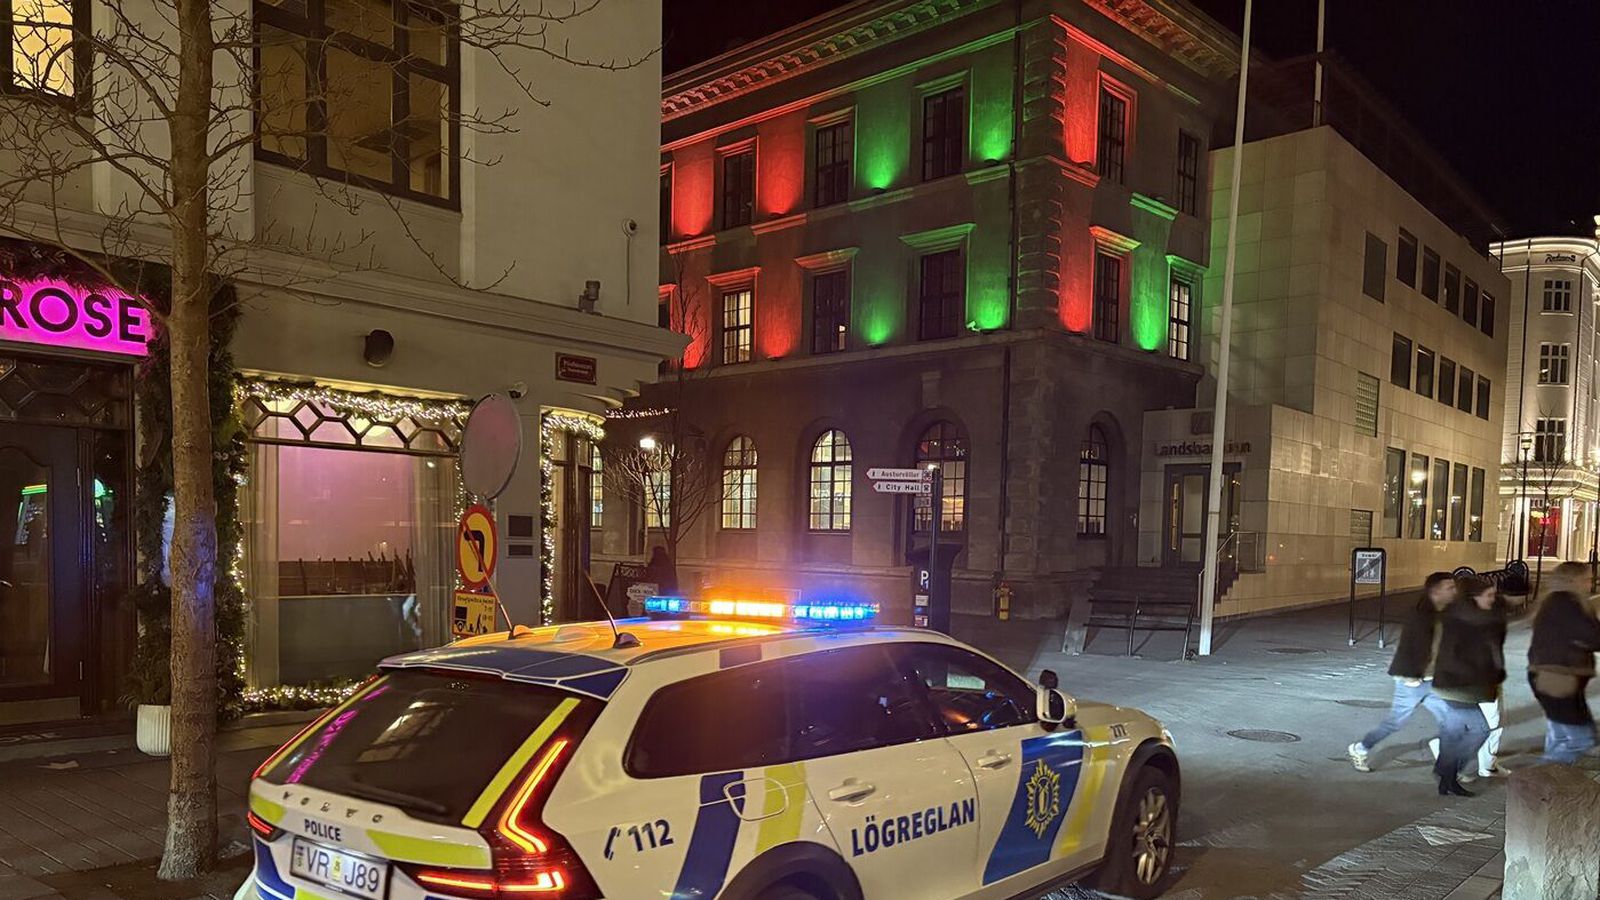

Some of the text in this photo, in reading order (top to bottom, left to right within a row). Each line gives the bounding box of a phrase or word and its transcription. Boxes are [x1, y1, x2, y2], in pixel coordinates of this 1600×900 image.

[0, 280, 146, 343] ROSE
[283, 791, 383, 823] VOLVO
[304, 819, 341, 841] POLICE
[628, 819, 674, 852] 112
[852, 798, 976, 858] LÖGREGLAN
[306, 847, 330, 879] VR
[344, 861, 380, 892] J89
